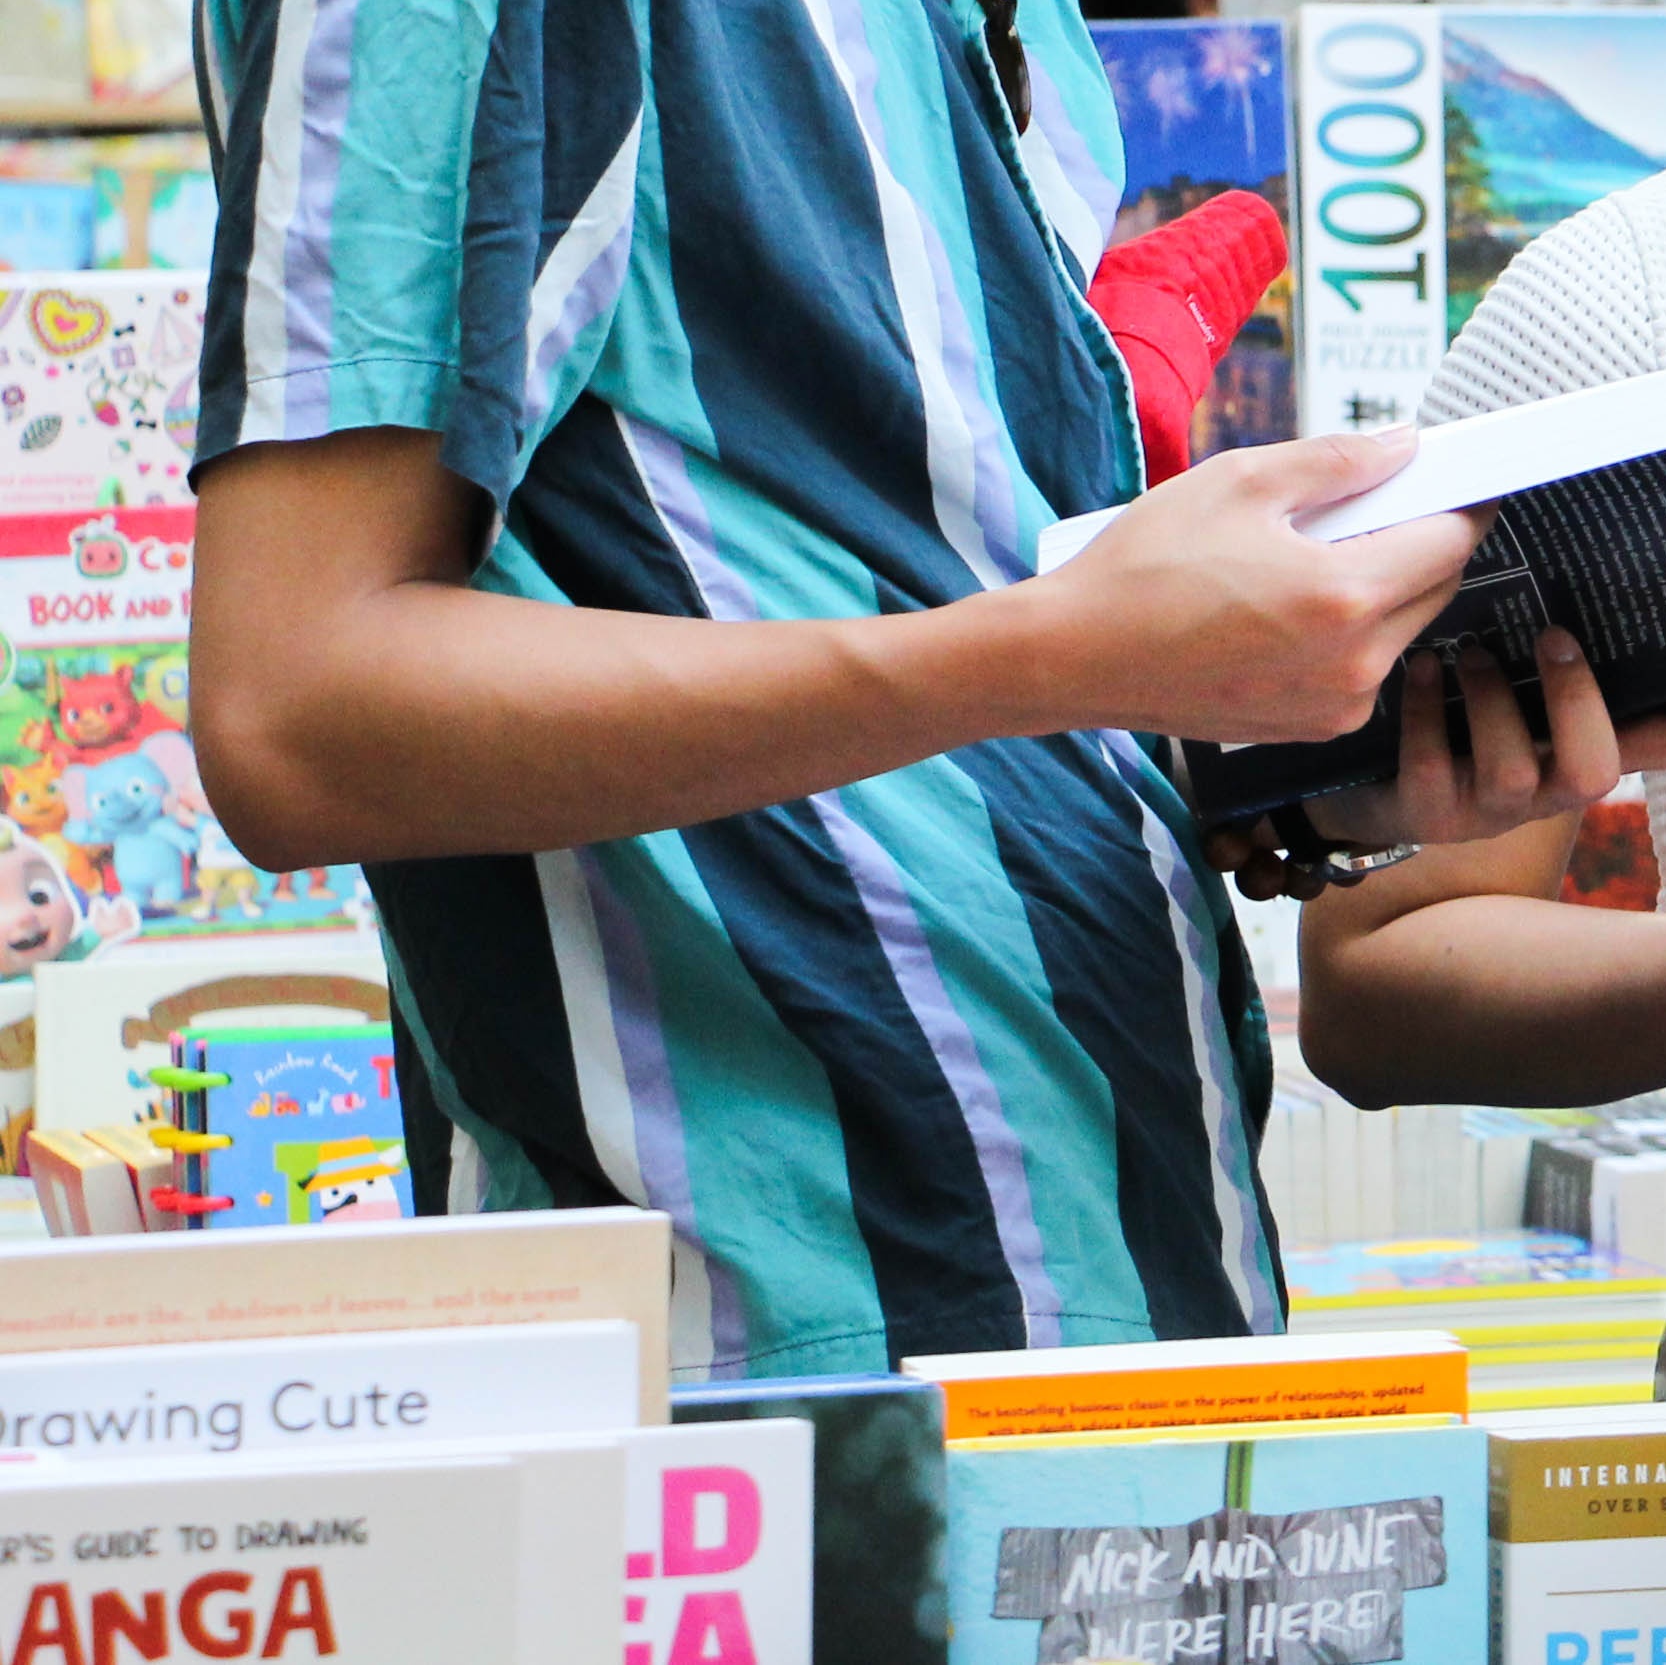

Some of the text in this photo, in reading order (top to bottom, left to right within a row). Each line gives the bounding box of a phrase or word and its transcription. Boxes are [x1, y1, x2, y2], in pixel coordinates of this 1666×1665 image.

[1317, 22, 1430, 311] 1000
[28, 588, 172, 626] BOOK AND
[271, 1382, 430, 1433] Cute
[1587, 1498, 1649, 1516] OVER
[75, 1518, 367, 1561] GUIDE TO DRAWING
[1061, 1513, 1416, 1603] NICK AND JUNE
[0, 1566, 339, 1665] ANGA
[1087, 1590, 1385, 1665] WERE HERE
